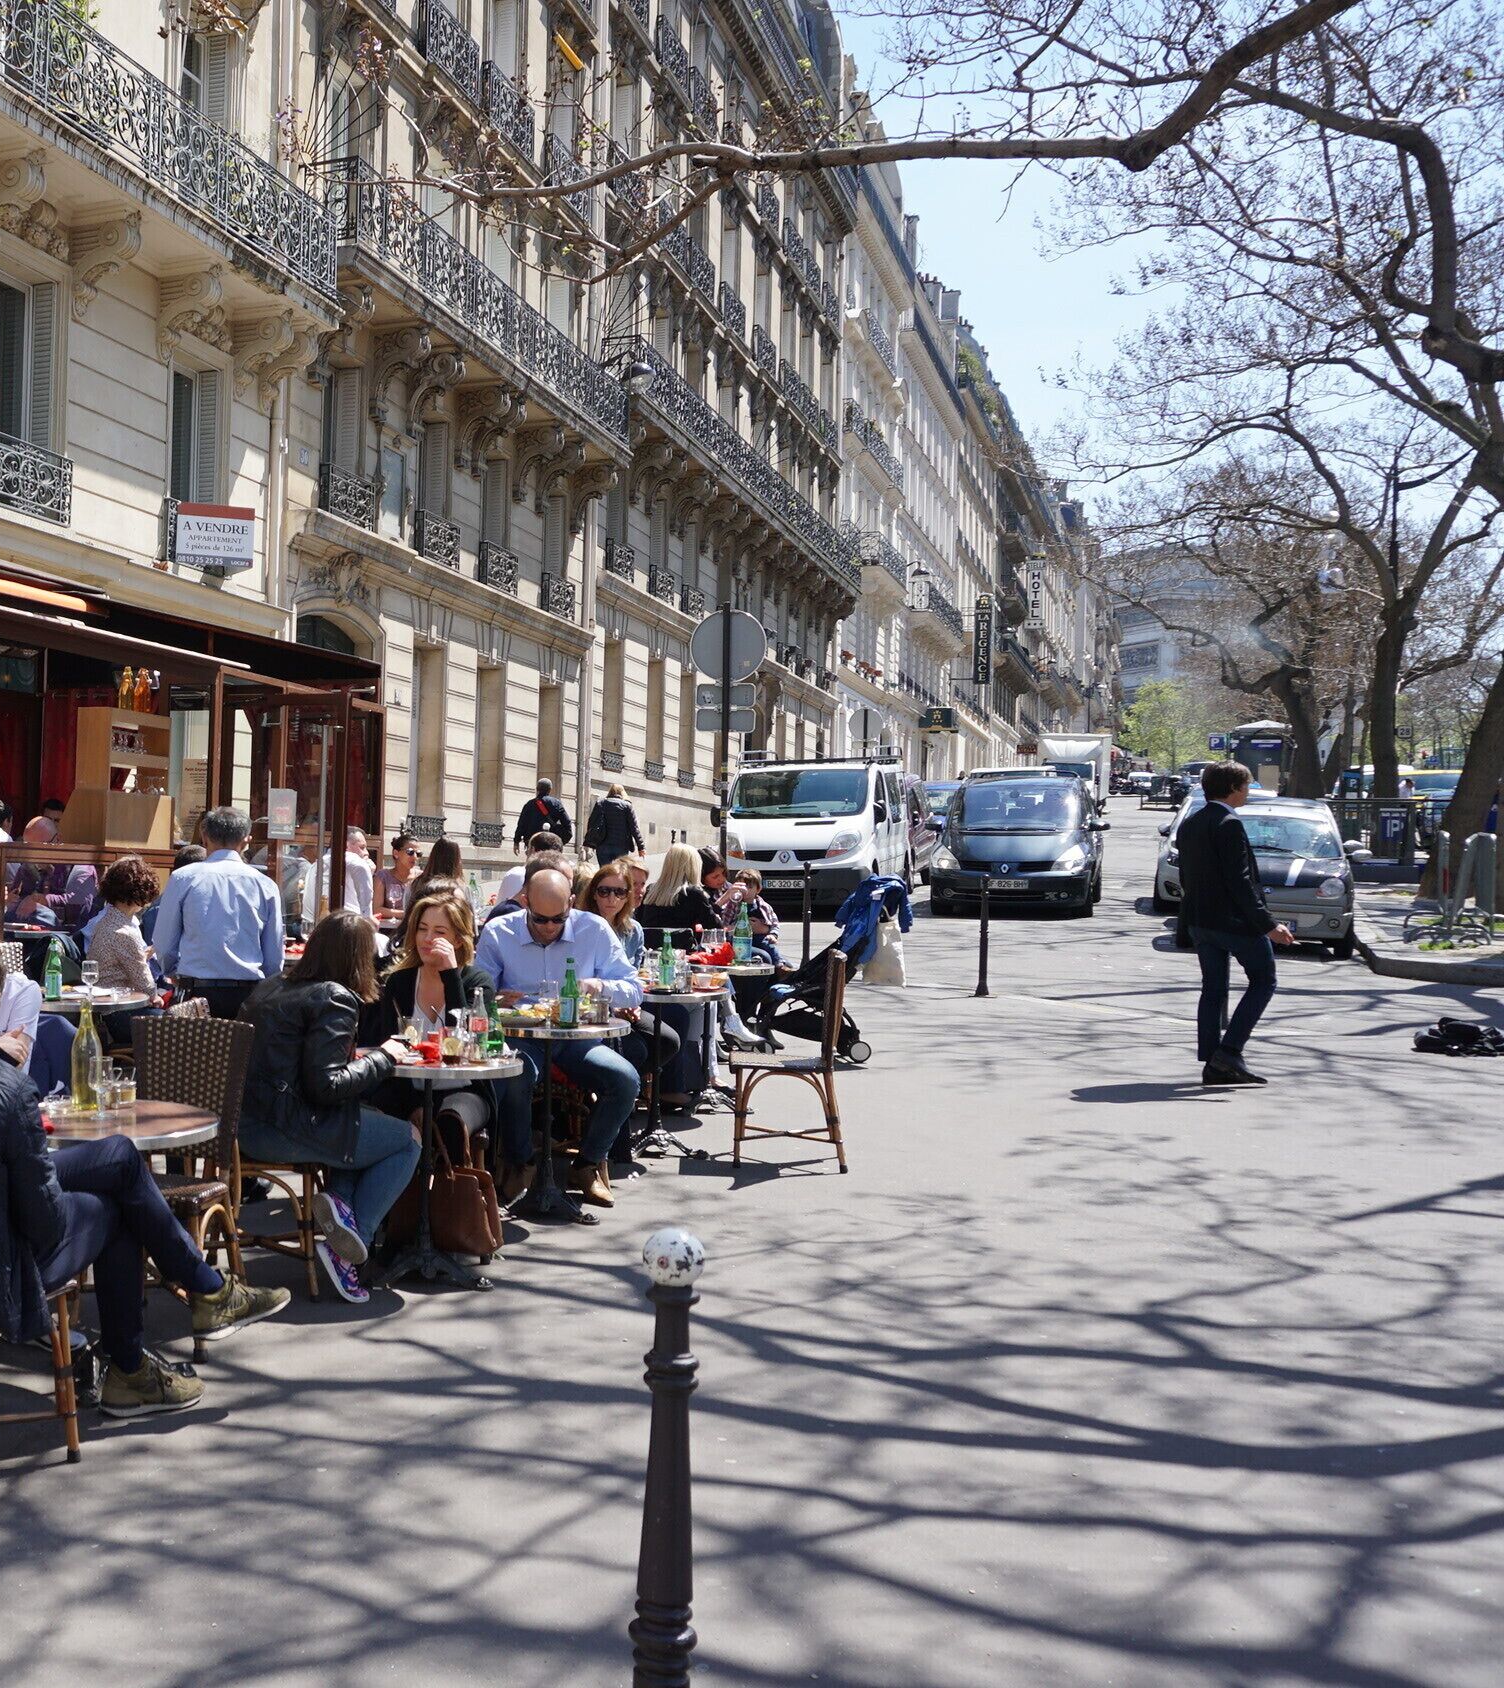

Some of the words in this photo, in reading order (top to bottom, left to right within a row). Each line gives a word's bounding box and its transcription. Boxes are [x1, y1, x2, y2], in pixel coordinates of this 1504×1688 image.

[183, 521, 192, 531] A
[196, 522, 249, 535] VENDRE
[188, 534, 242, 544] APPARTEMENT
[191, 542, 211, 550] pièces
[177, 555, 194, 563] 0810
[1031, 572, 1041, 618] HOTEL
[978, 622, 988, 681] REGENCE
[1400, 728, 1411, 736] 28
[1211, 738, 1220, 747] P
